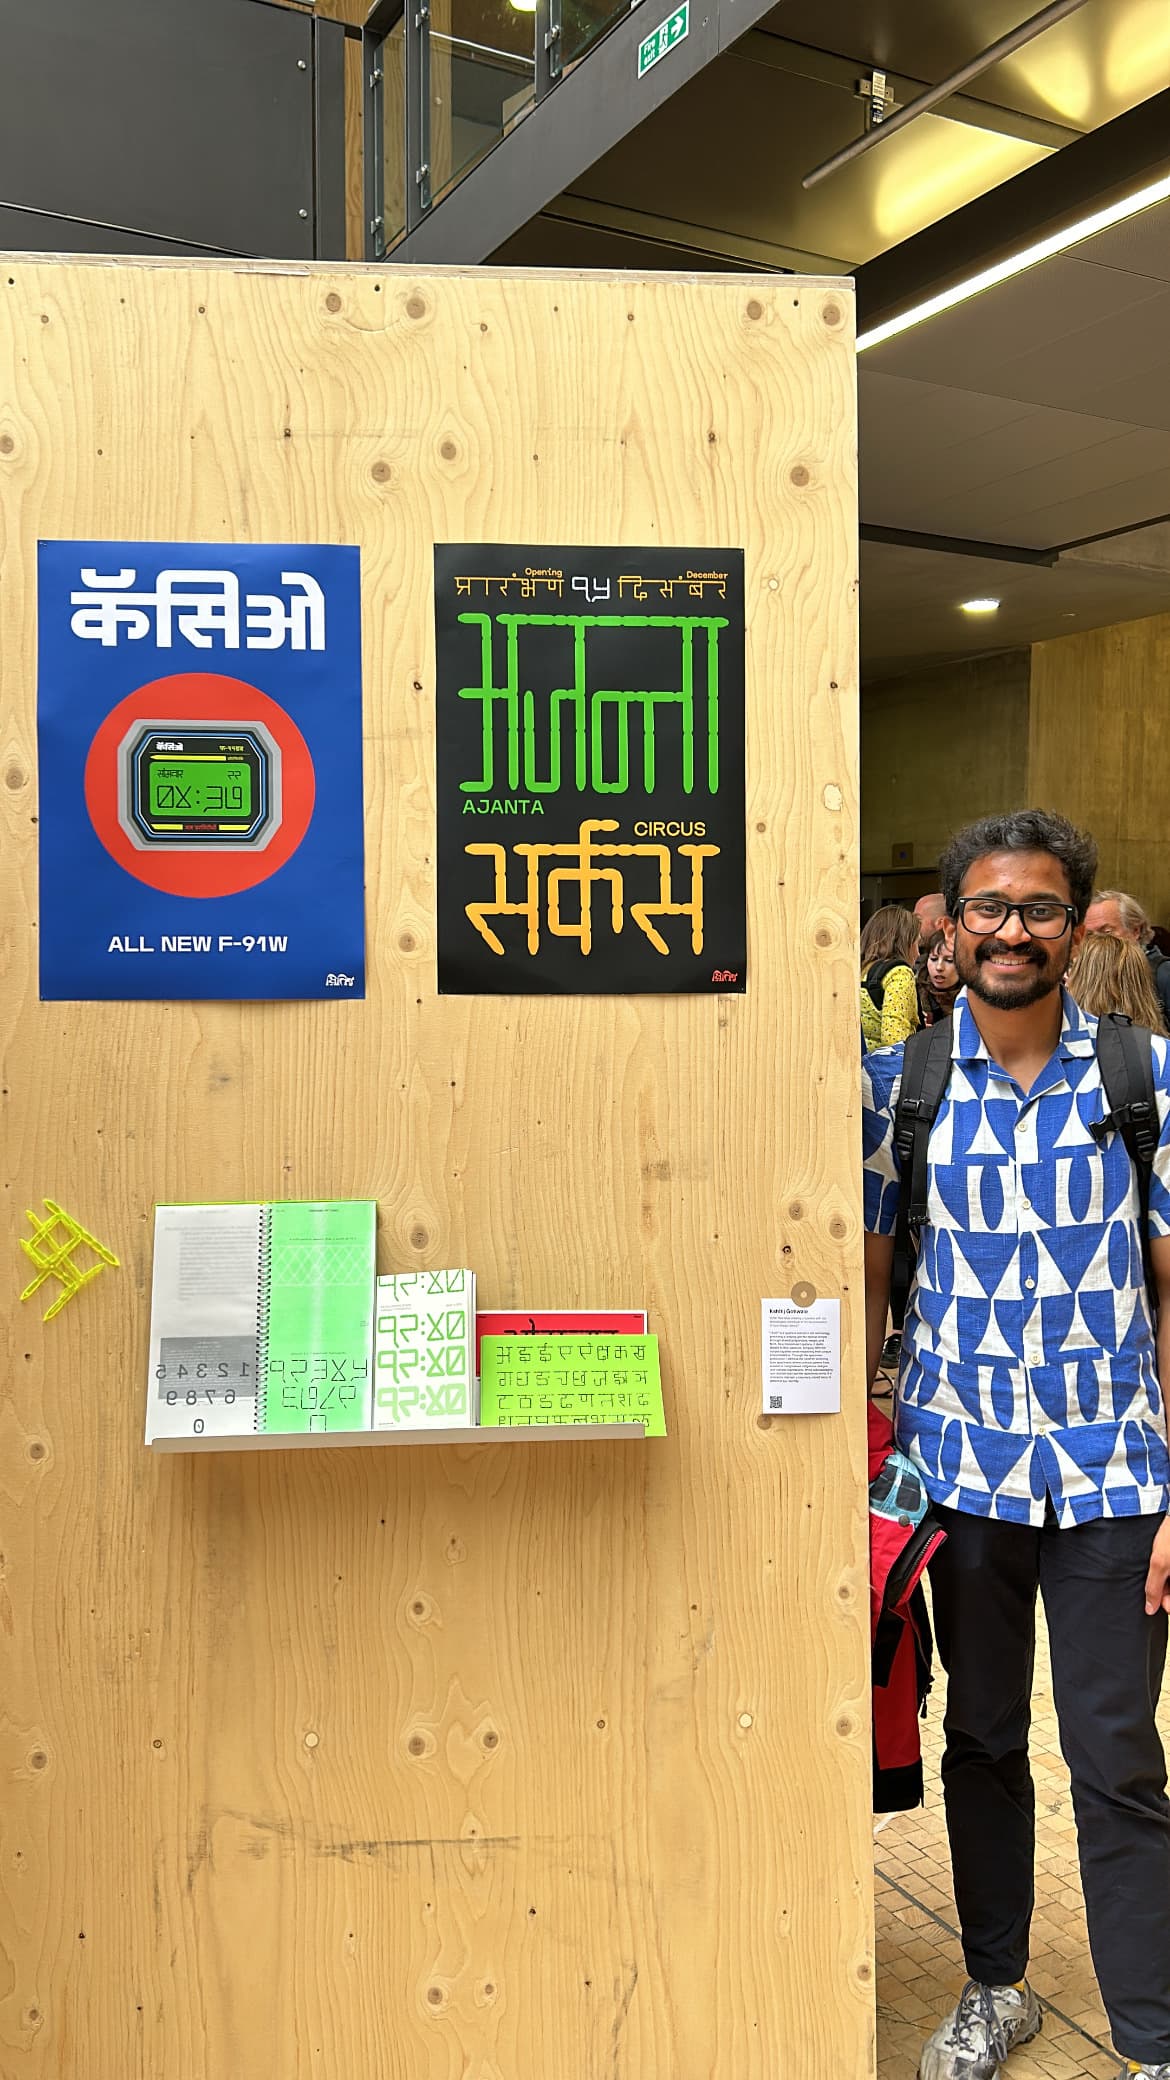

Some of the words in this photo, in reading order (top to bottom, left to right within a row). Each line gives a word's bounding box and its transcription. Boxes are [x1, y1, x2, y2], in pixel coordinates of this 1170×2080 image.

[643, 39, 656, 55] Fire
[643, 49, 656, 66] exit
[525, 567, 563, 579] Opening
[686, 570, 729, 580] December
[462, 800, 545, 815] AJANTA
[633, 821, 706, 837] CIRCUS
[108, 936, 155, 953] ALL
[161, 936, 212, 953] NEW
[218, 936, 288, 953] F-91W
